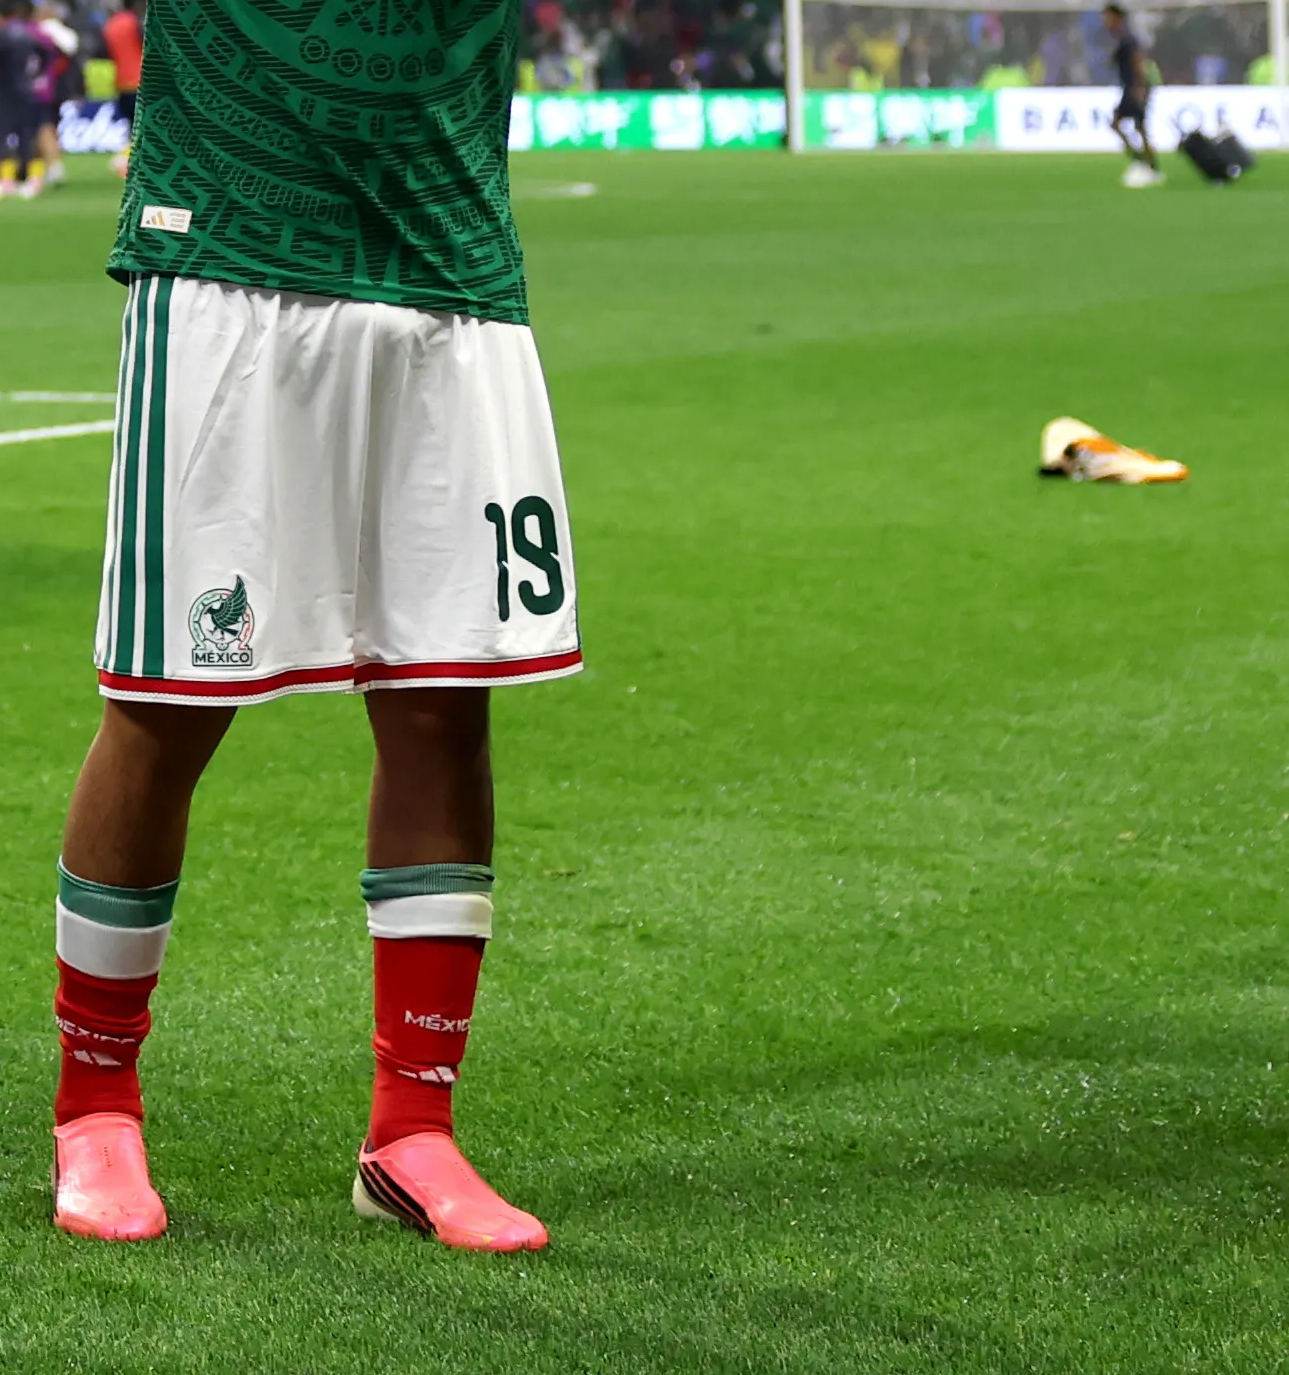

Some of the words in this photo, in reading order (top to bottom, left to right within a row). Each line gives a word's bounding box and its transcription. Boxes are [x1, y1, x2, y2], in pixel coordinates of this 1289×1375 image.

[484, 495, 565, 622] 19
[195, 649, 250, 663] MÉXICO
[404, 1009, 471, 1034] MÉXIC
